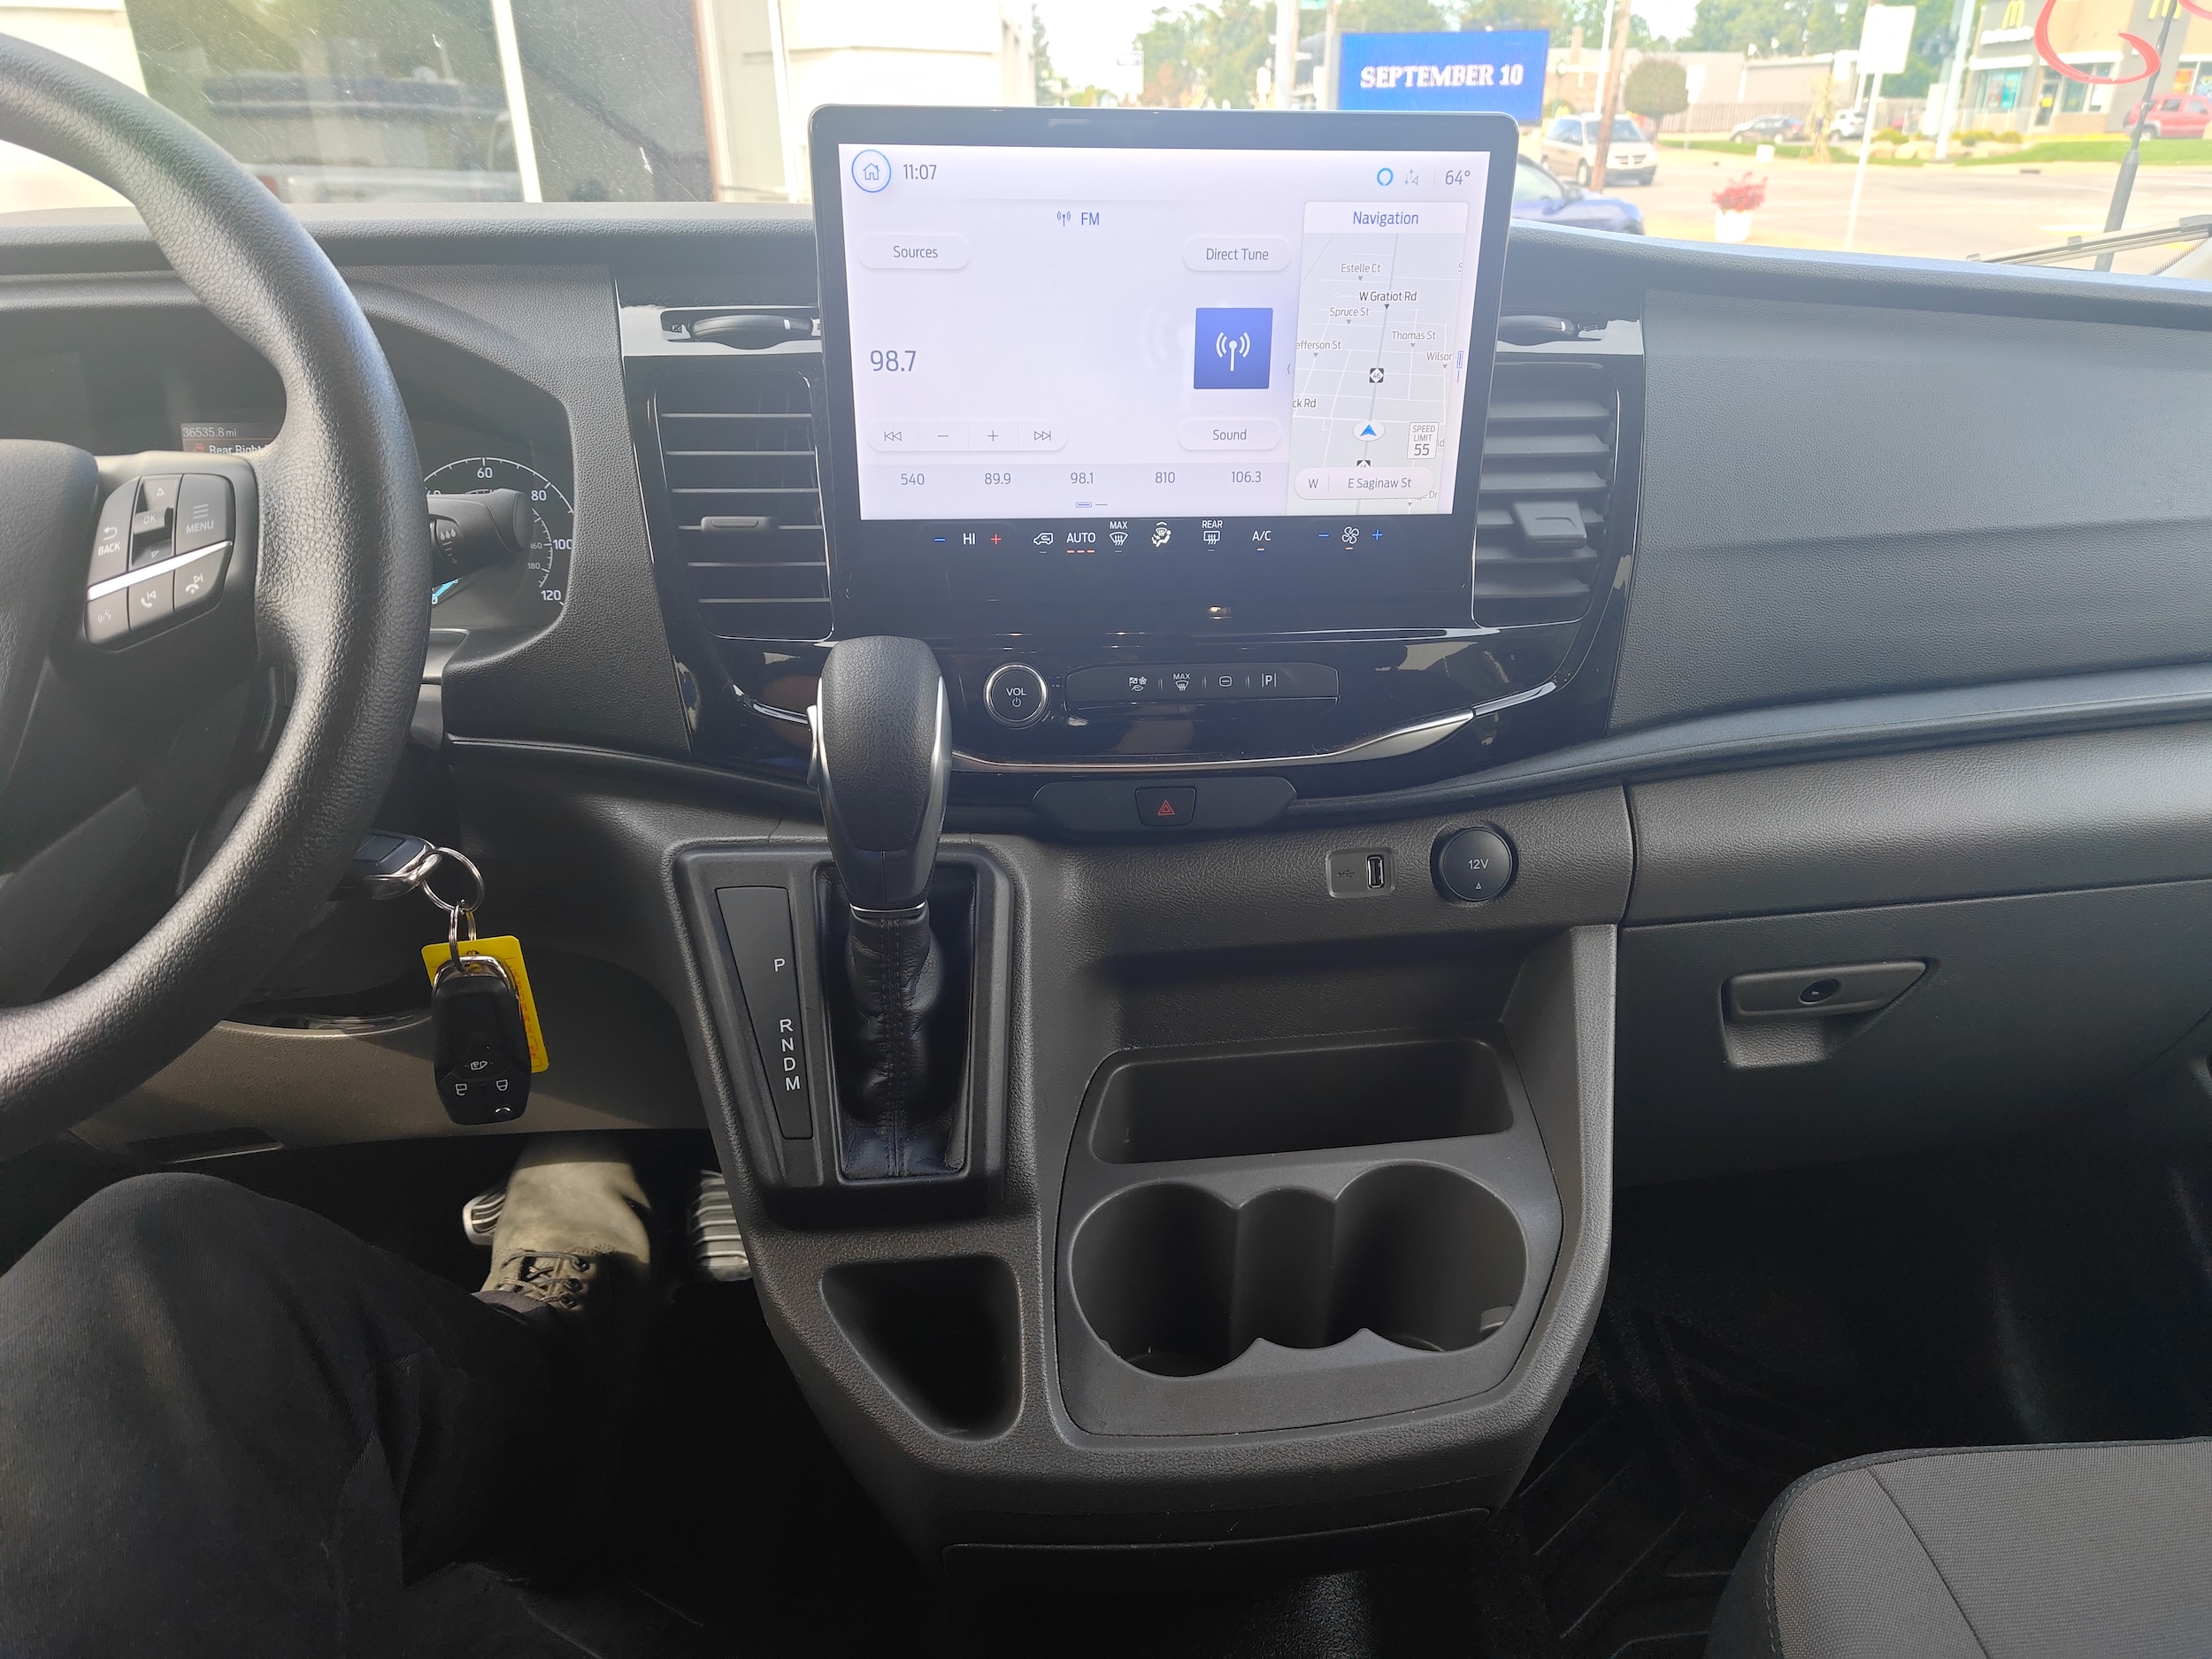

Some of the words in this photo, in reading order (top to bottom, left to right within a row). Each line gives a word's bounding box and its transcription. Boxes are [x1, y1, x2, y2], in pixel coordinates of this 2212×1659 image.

[1360, 65, 1495, 88] SEPTEMBER
[1499, 63, 1525, 86] 10
[902, 164, 937, 180] 11:07
[1445, 170, 1471, 186] 64°
[1081, 211, 1100, 226] FM
[1353, 211, 1419, 227] Navigation
[893, 245, 939, 258] Sources
[1206, 248, 1239, 261] Direct
[1240, 248, 1269, 261] Tune
[1340, 263, 1371, 273] Estelle
[1371, 263, 1381, 273] Ct
[1359, 291, 1369, 302] W
[1370, 291, 1403, 302] Gratiot
[1404, 290, 1417, 302] Rd
[1329, 307, 1359, 319] Spruce
[1360, 306, 1371, 317] St
[1391, 330, 1425, 340] Thomas
[1426, 330, 1436, 340] St
[1332, 340, 1341, 349] St
[870, 349, 917, 373] 98.7
[1303, 397, 1317, 408] Rd
[182, 426, 225, 438] 36535.8
[226, 428, 237, 437] mi
[1212, 428, 1248, 441] Sound
[1412, 425, 1436, 434] SPEED
[1413, 434, 1433, 442] LIMIT
[209, 445, 233, 454] Rear
[1413, 443, 1430, 457] 55
[476, 466, 493, 479] 60
[901, 472, 925, 486] 540
[984, 472, 1011, 485] 89.9
[1070, 472, 1094, 485] 98.1
[1155, 471, 1176, 484] 810
[1231, 471, 1262, 483] 106.3
[1308, 478, 1319, 489] W
[1348, 478, 1355, 488] E
[1356, 478, 1400, 491] Saginaw
[1401, 477, 1412, 488] St
[531, 489, 547, 502] 80
[142, 514, 157, 525] OK
[1110, 520, 1128, 530] MAX
[1202, 519, 1224, 529] REAR
[186, 519, 214, 535] MENU
[963, 533, 976, 545] HI
[1066, 532, 1096, 543] AUTO
[1252, 530, 1271, 541] A/C
[97, 541, 121, 556] BACK
[552, 538, 573, 549] 100
[541, 589, 562, 601] 120
[1005, 687, 1027, 696] VOL
[1468, 858, 1489, 870] 12V
[773, 957, 786, 972] P
[780, 1018, 794, 1033] R
[781, 1037, 795, 1052] N
[783, 1056, 796, 1071] D
[785, 1075, 801, 1091] M
